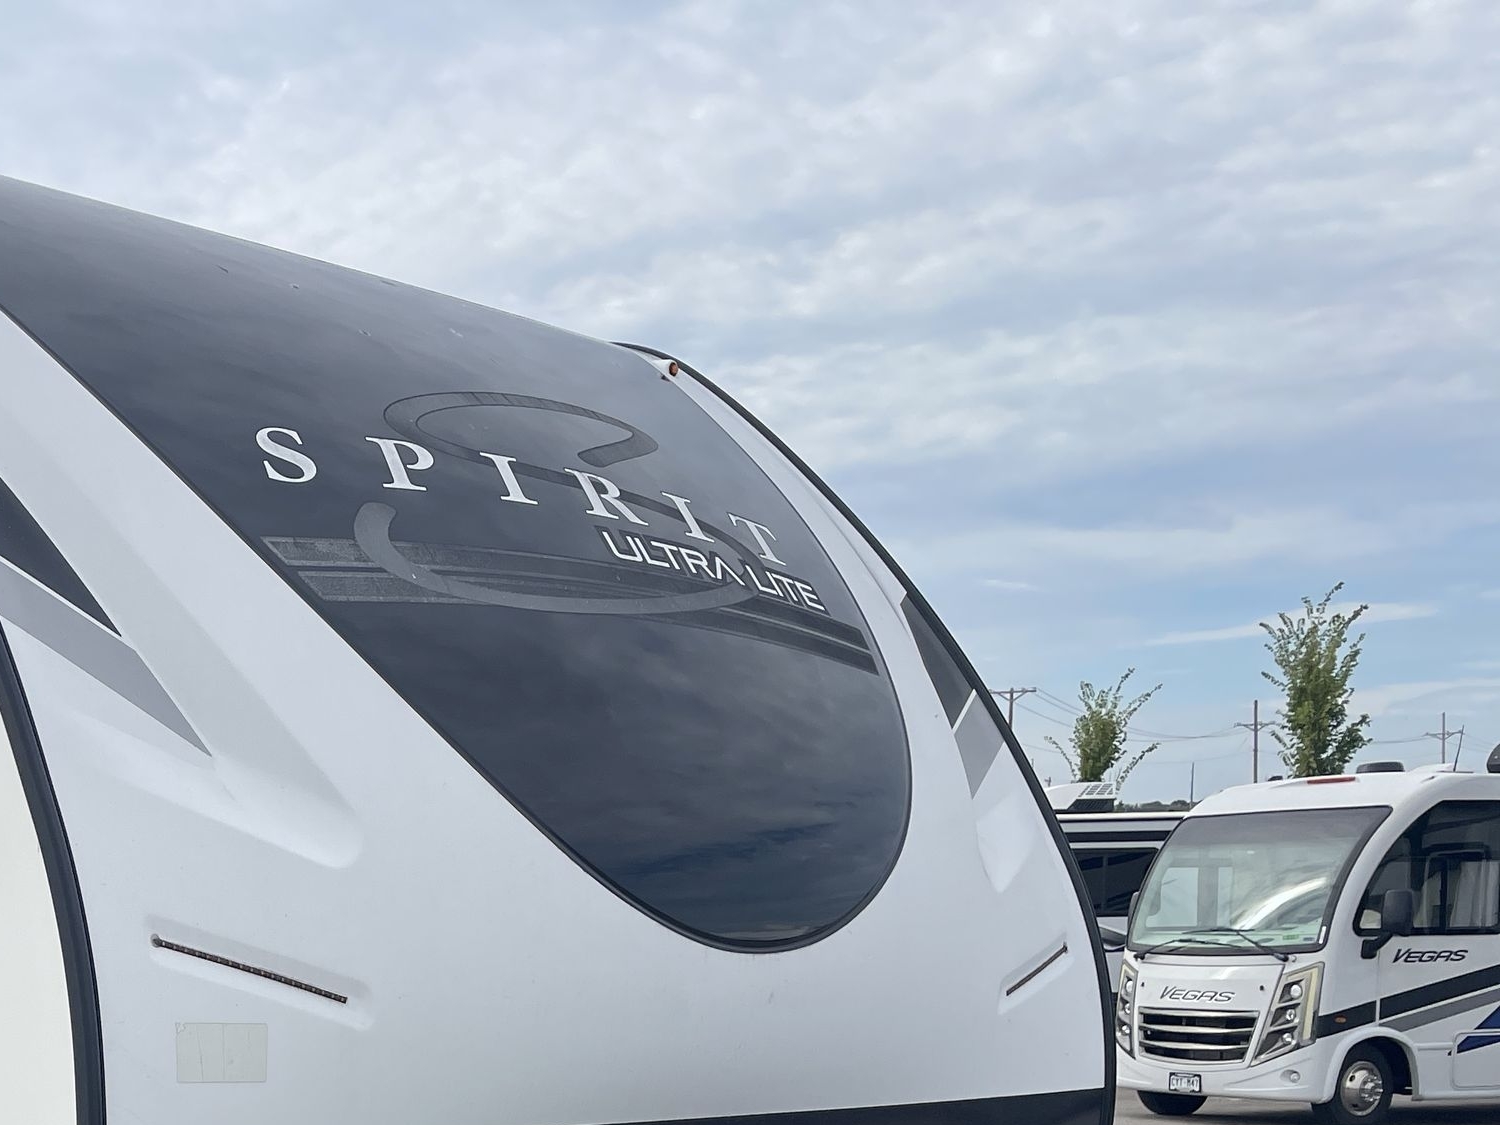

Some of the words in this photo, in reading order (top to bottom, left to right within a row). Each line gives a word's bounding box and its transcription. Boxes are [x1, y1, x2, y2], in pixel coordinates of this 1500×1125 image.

[255, 427, 786, 565] SPIRIT
[602, 531, 746, 586] ULTRA
[744, 564, 825, 611] LITE
[1392, 948, 1469, 964] VEGAS
[1160, 985, 1236, 1003] VEGAS
